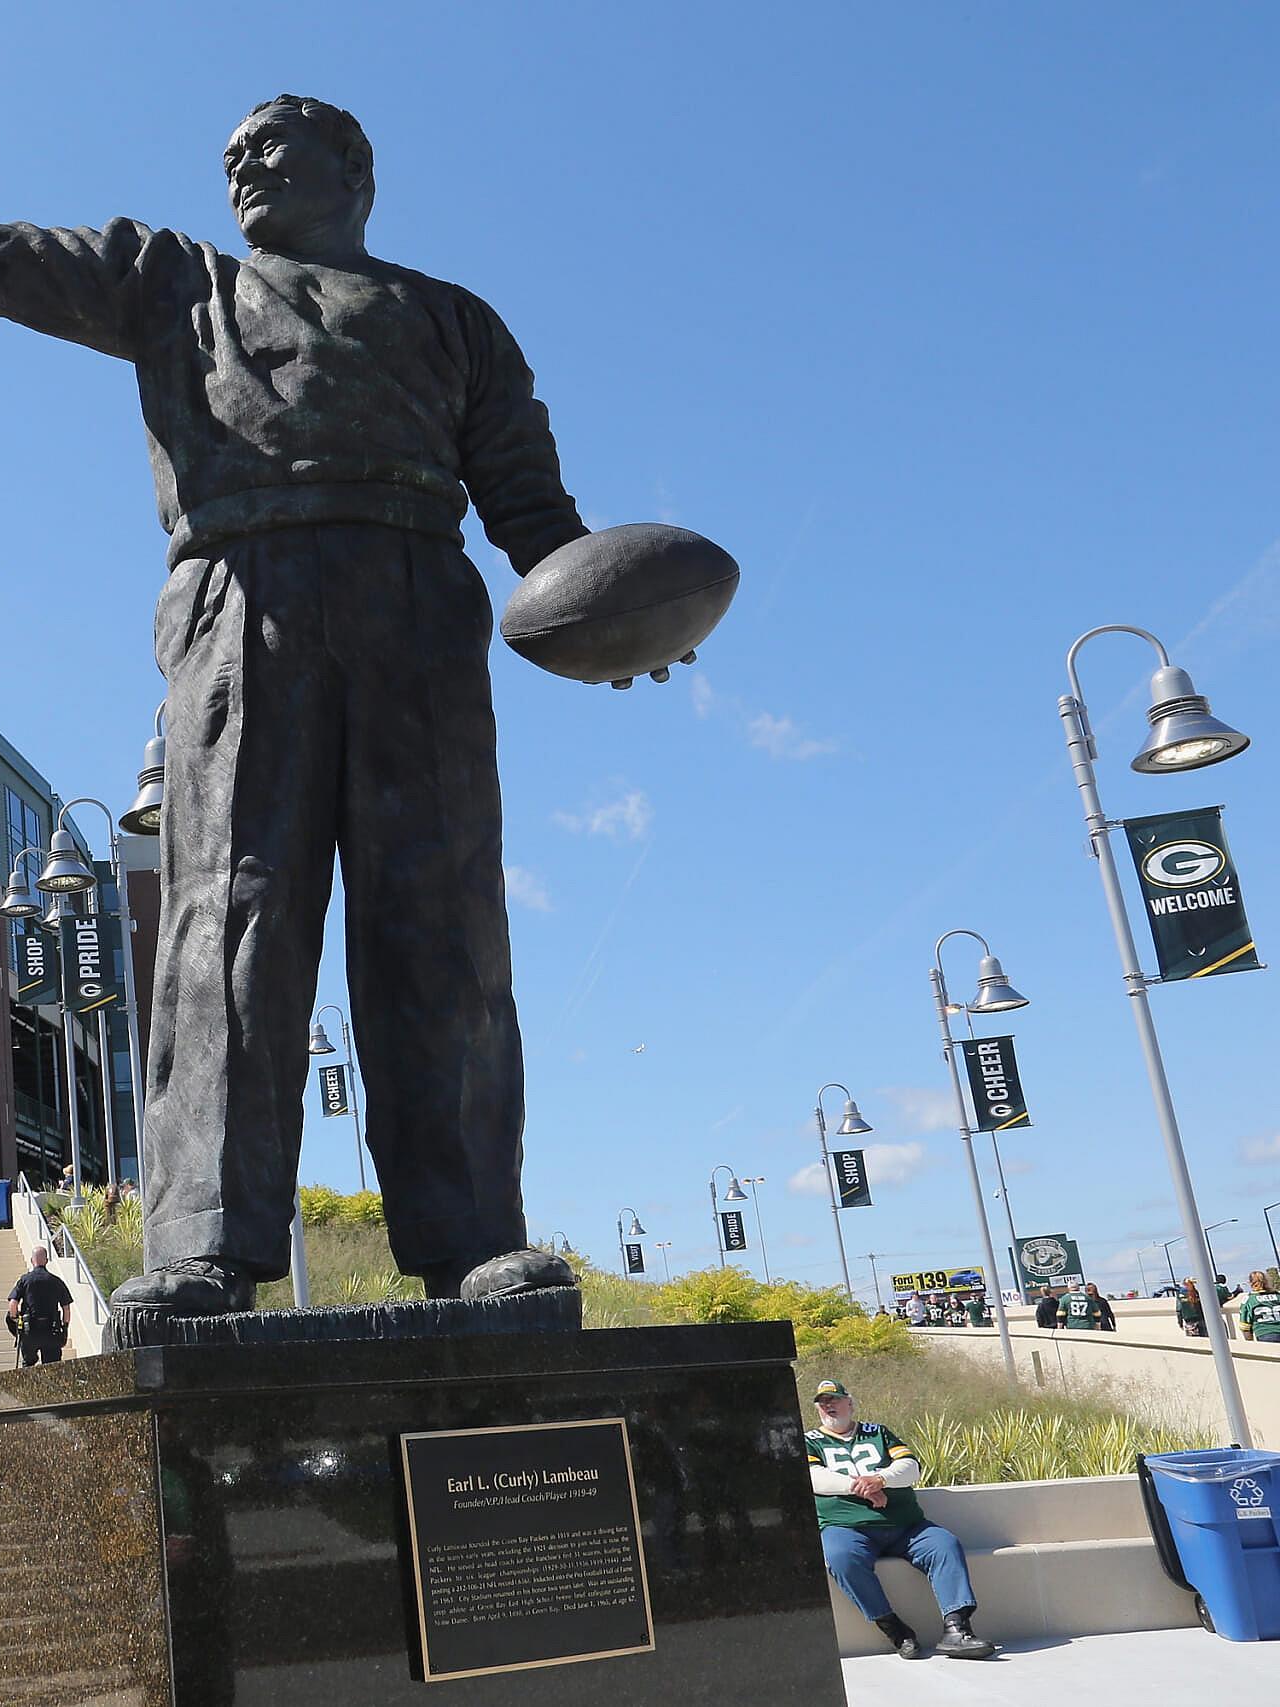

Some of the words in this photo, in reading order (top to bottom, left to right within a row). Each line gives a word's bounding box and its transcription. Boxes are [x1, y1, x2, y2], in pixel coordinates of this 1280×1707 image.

[1150, 887, 1236, 916] WELCOME
[26, 937, 44, 976] SHOP
[75, 918, 101, 978] PRIDE
[326, 1067, 340, 1101] CHEER
[977, 1042, 1009, 1101] CHEER
[842, 1153, 860, 1184] SHOP
[726, 1213, 740, 1239] PRIDE
[892, 1275, 914, 1286] Ford
[916, 1271, 948, 1290] 139
[1070, 1301, 1088, 1316] 87
[823, 1443, 882, 1477] 52
[447, 1475, 473, 1493] Earl
[478, 1475, 490, 1491] L.
[493, 1469, 539, 1490] (Curly)
[543, 1466, 599, 1484] Lambeau
[568, 1487, 597, 1499] 1919-49
